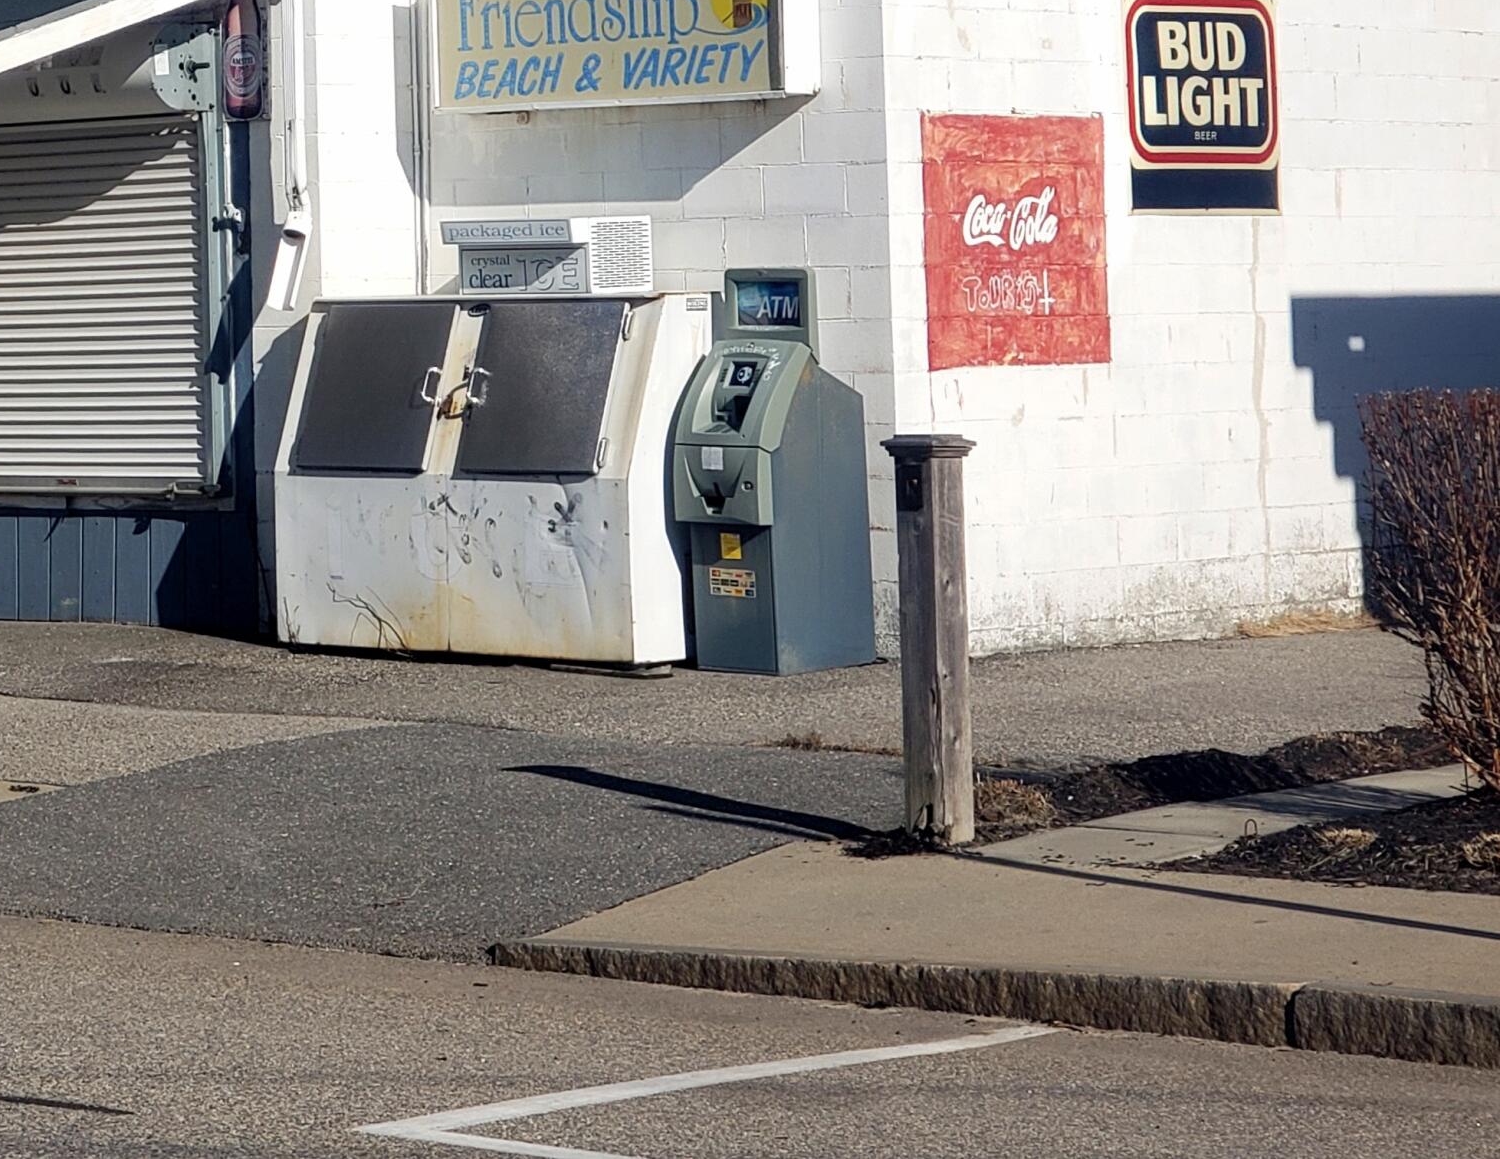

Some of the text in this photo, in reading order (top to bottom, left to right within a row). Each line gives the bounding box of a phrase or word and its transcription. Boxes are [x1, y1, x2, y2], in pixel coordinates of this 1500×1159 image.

[1157, 21, 1246, 71] BUD
[453, 39, 764, 100] BEACH & VARIETY
[1143, 75, 1264, 127] LIGHT
[1194, 130, 1218, 141] BEER
[449, 223, 565, 240] packaged ice
[470, 254, 510, 270] crystal
[468, 269, 512, 289] clear
[515, 257, 580, 291] ICE
[757, 296, 799, 319] ATM
